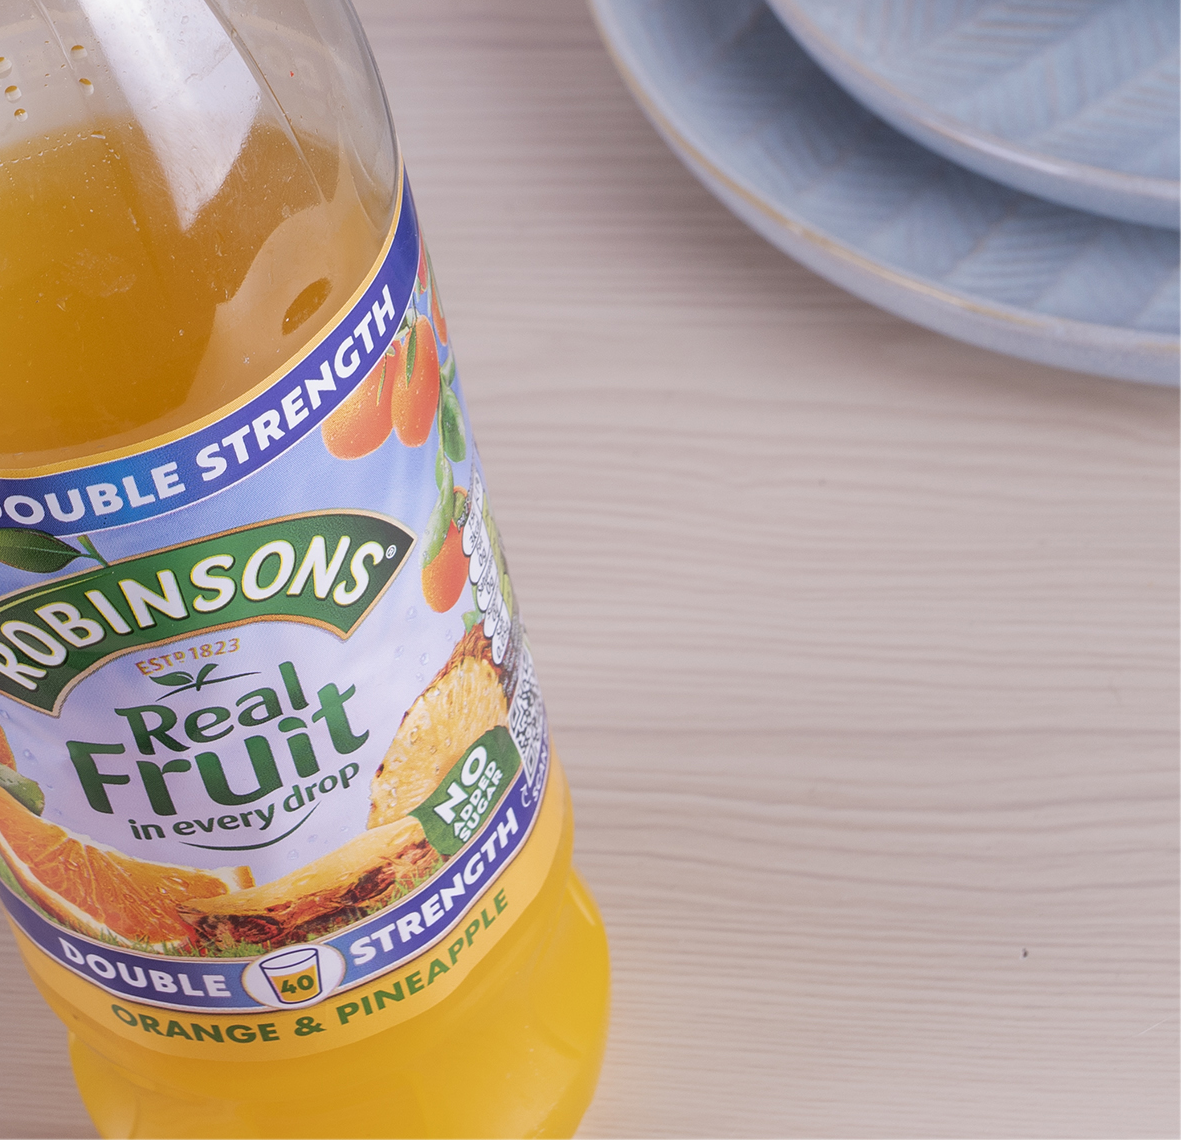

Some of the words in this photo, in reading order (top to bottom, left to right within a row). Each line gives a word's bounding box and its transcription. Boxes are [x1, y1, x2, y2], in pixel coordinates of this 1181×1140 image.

[195, 284, 396, 482] STRENGTH
[188, 637, 240, 660] 1823
[114, 661, 310, 756] Real
[65, 682, 370, 817] Fruit
[433, 745, 488, 825] NO
[127, 818, 166, 840] in
[172, 803, 275, 837] every
[282, 762, 360, 813] drop
[453, 760, 497, 837] ADDED
[459, 769, 504, 843] SUGAR
[57, 936, 232, 998] DOUBLE
[349, 806, 519, 967] STRENGTH
[110, 1003, 281, 1044] ORANGE
[293, 1015, 327, 1038] &
[335, 887, 509, 1026] PINEAPPLE
[280, 974, 315, 994] 40
